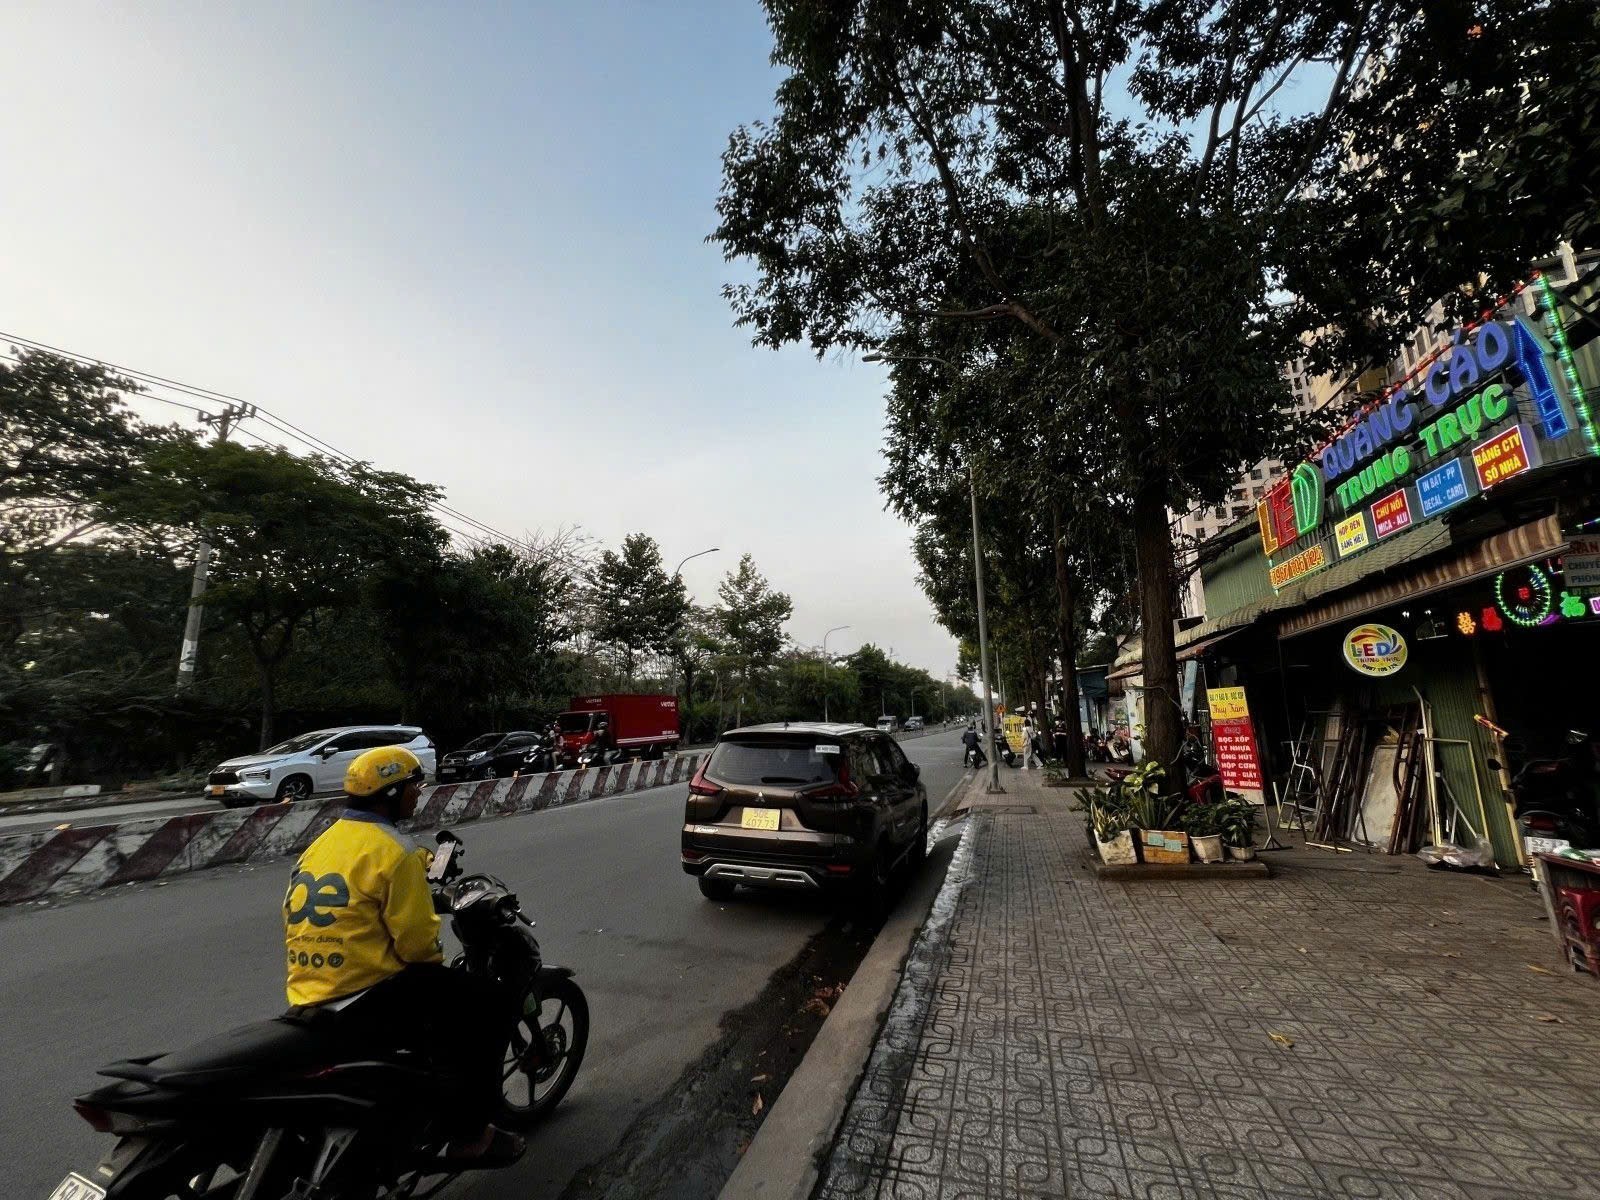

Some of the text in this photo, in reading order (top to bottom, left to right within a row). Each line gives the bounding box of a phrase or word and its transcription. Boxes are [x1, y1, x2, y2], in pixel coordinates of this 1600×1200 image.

[1323, 321, 1510, 480] QUẢNG CÁO
[1336, 384, 1508, 509] TRUNG TRỰC
[1474, 433, 1521, 467] BẢNG CTY
[1446, 467, 1455, 480] PP
[1499, 454, 1522, 475] NHÀ
[1257, 463, 1318, 556] LED
[1424, 494, 1443, 510] DECAL
[1378, 520, 1393, 533] MICA
[1396, 512, 1408, 526] ALU
[1351, 642, 1391, 657] LED
